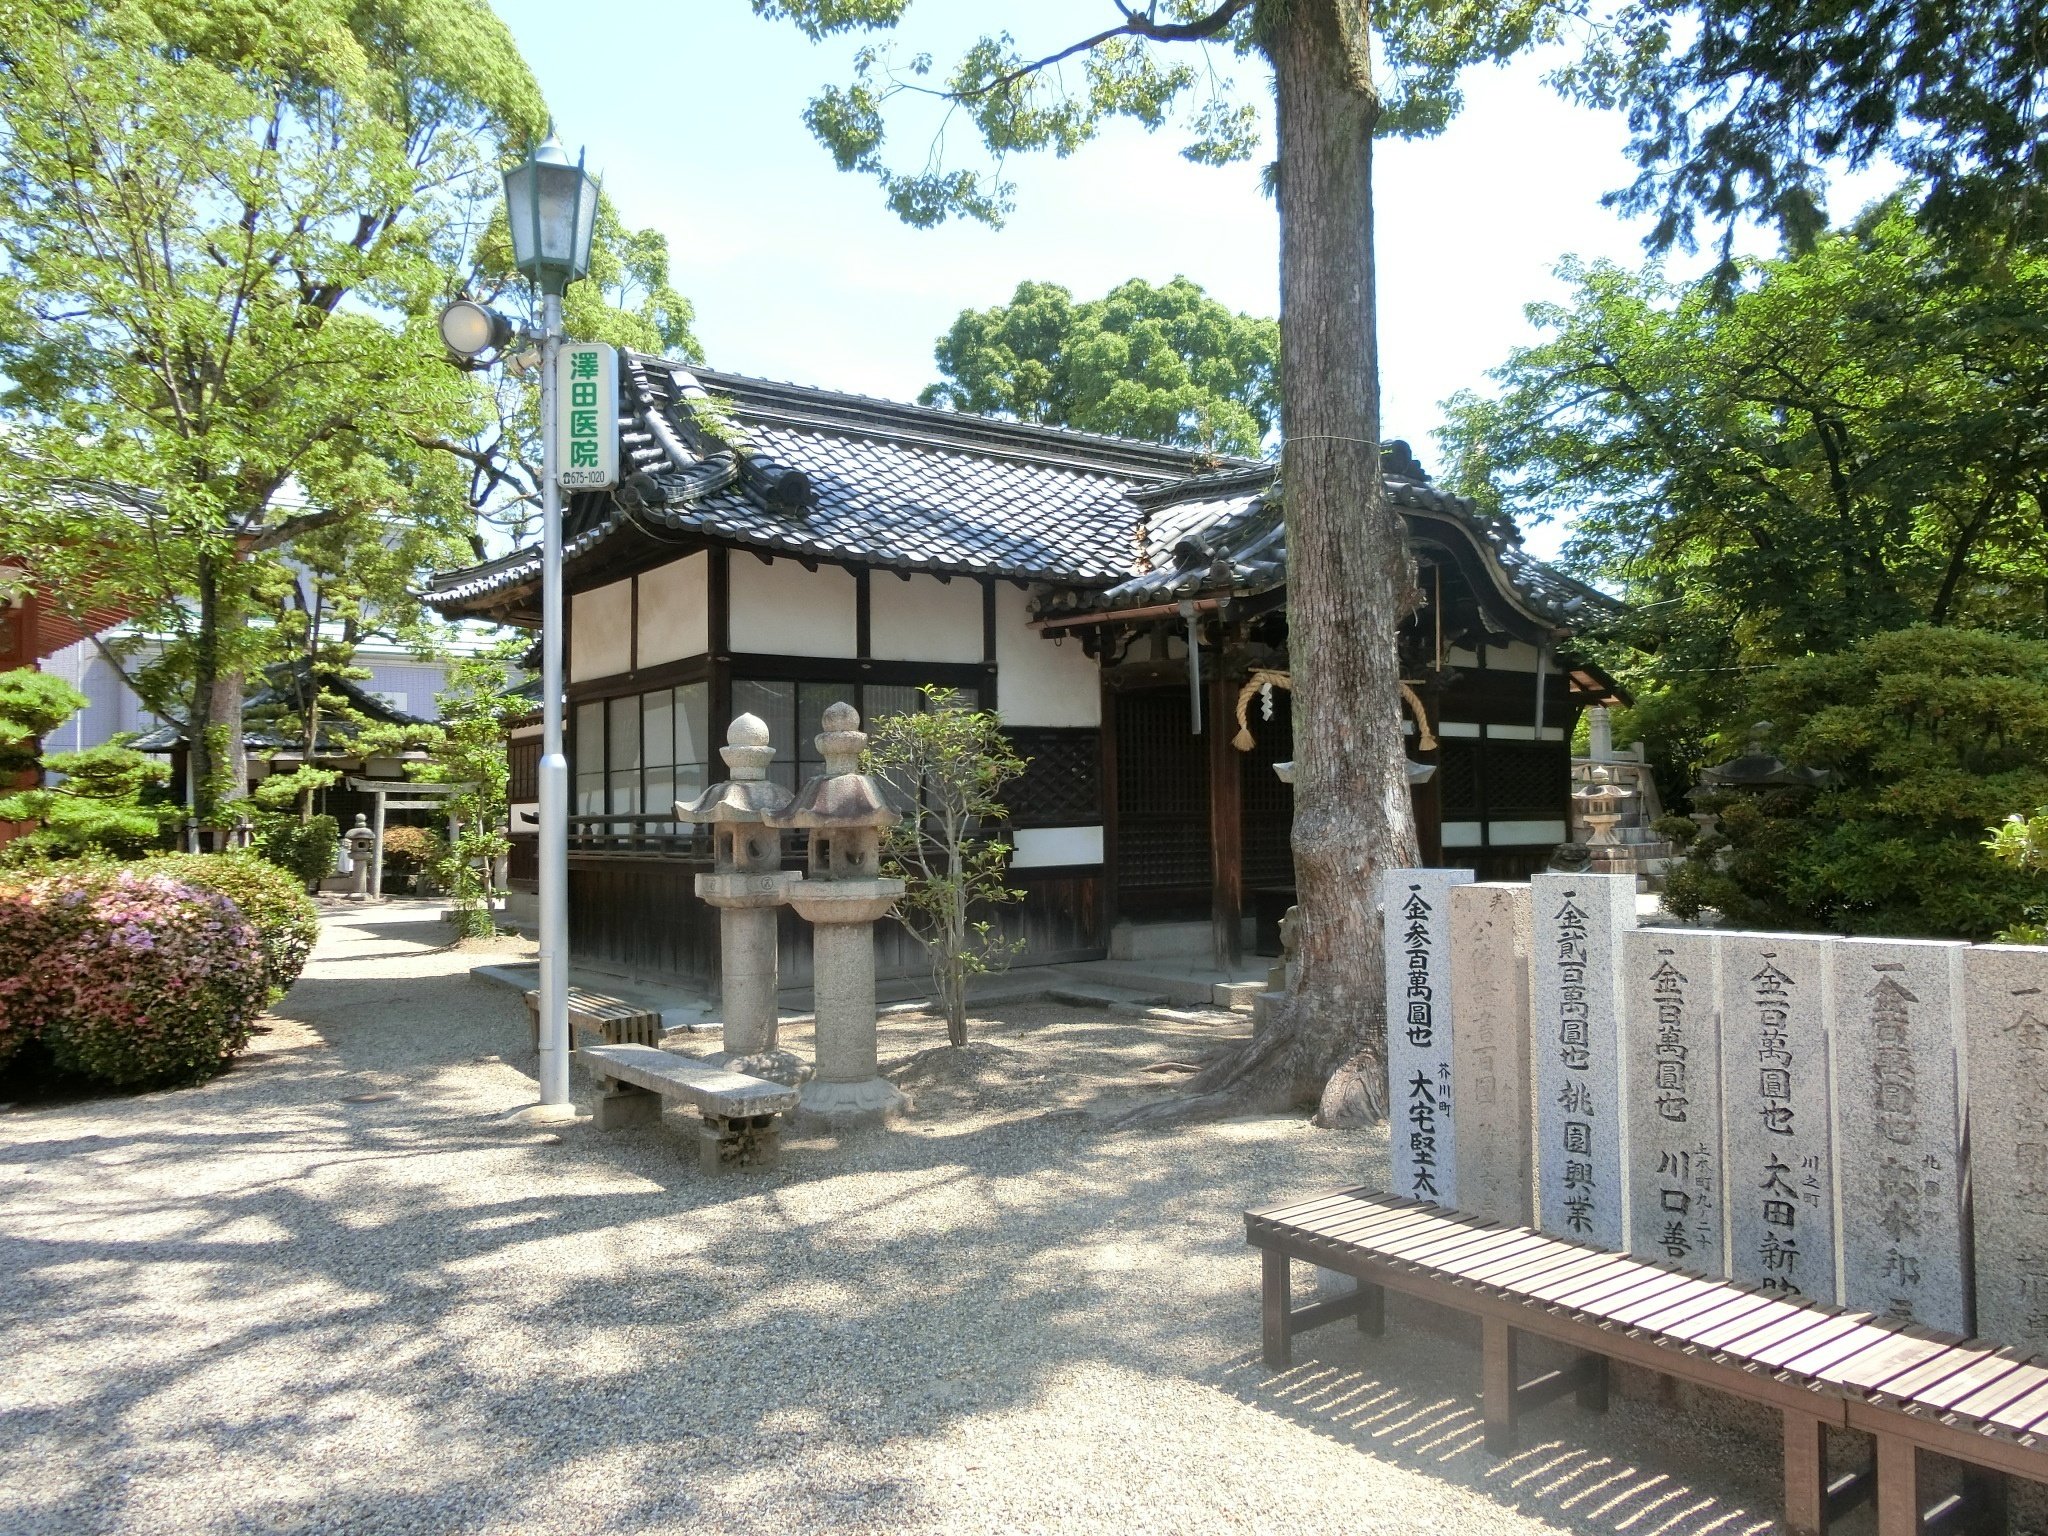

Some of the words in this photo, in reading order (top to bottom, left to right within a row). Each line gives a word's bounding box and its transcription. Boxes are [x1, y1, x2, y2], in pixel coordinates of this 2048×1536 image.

[570, 352, 599, 468] 澤田医院
[570, 471, 605, 484] 675-1020
[1438, 1062, 1451, 1117] 芥川町
[1656, 1151, 1692, 1264] 川口善
[1801, 1155, 1821, 1209] 川之町
